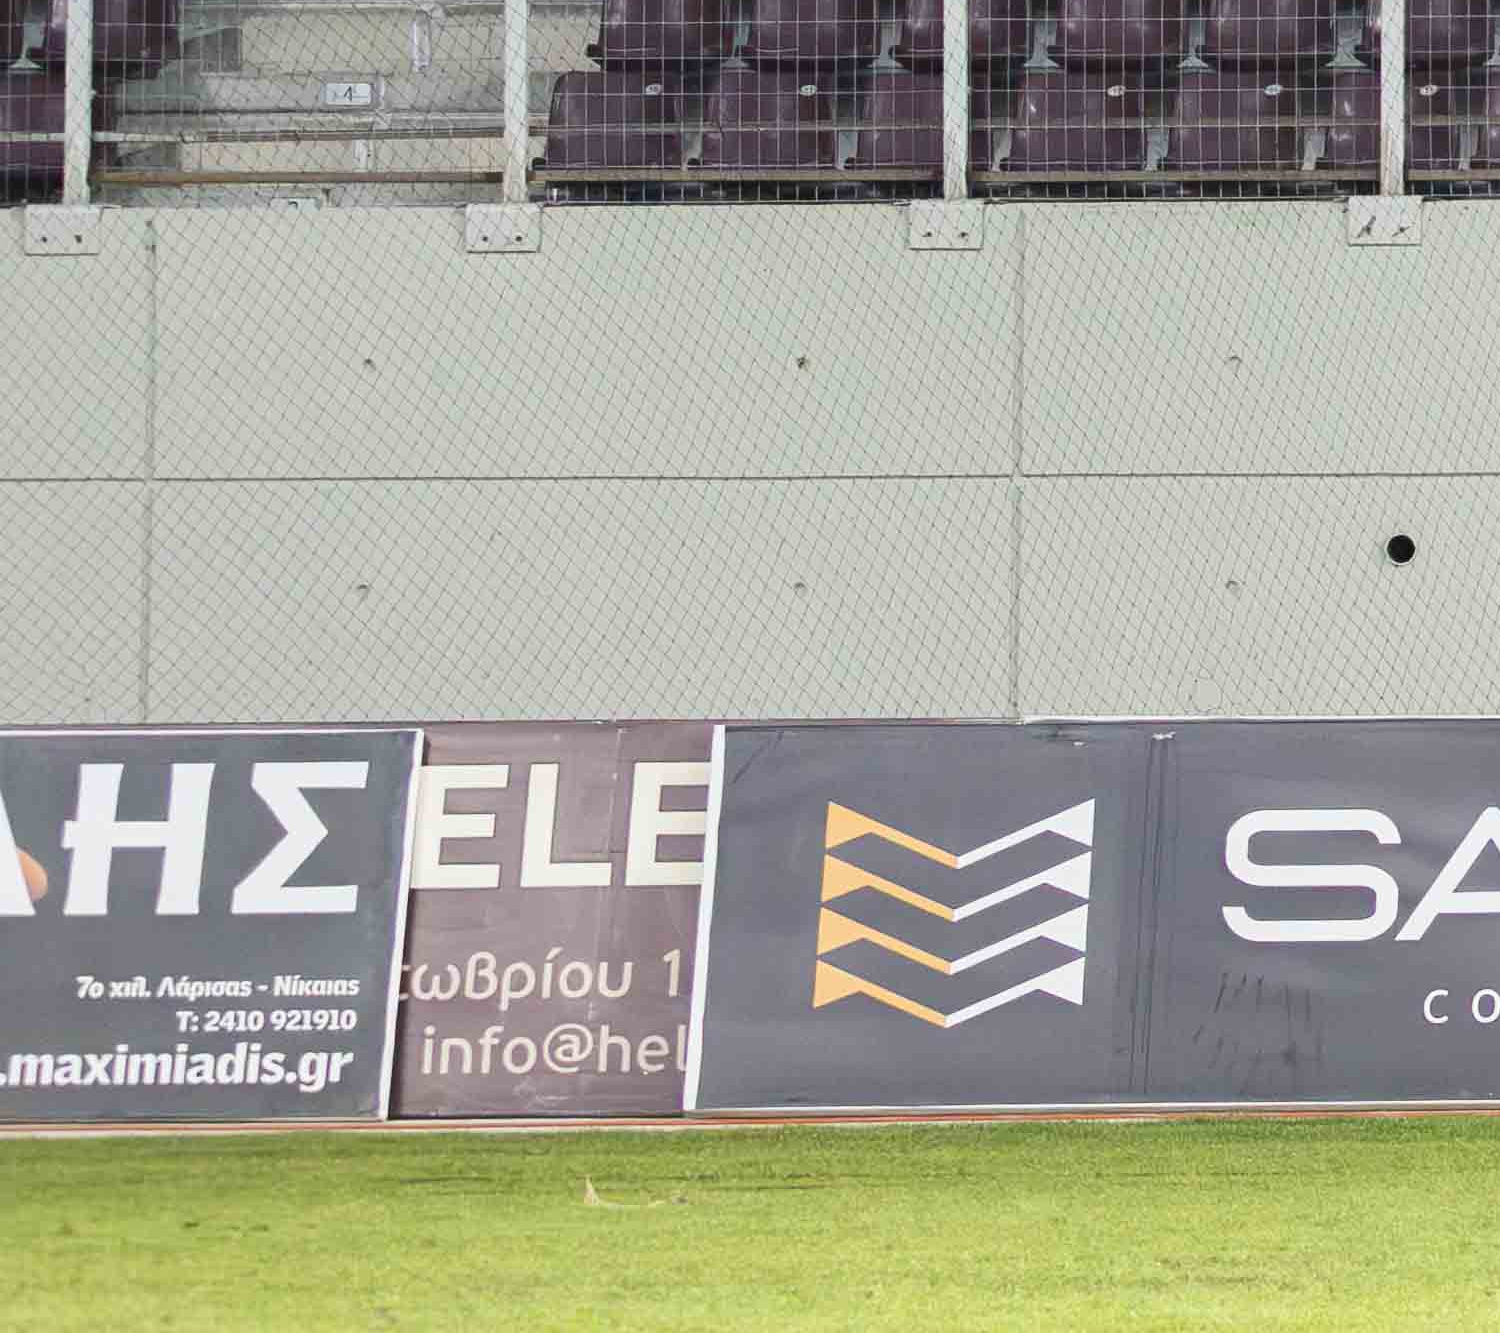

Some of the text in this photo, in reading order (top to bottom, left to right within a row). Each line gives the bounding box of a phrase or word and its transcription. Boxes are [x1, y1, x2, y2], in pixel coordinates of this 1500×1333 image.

[664, 948, 682, 998] 1
[157, 975, 252, 1001] Λάρισας
[273, 974, 361, 998] Νίκαιας
[203, 1010, 265, 1032] 2410
[270, 1009, 357, 1031] 921910
